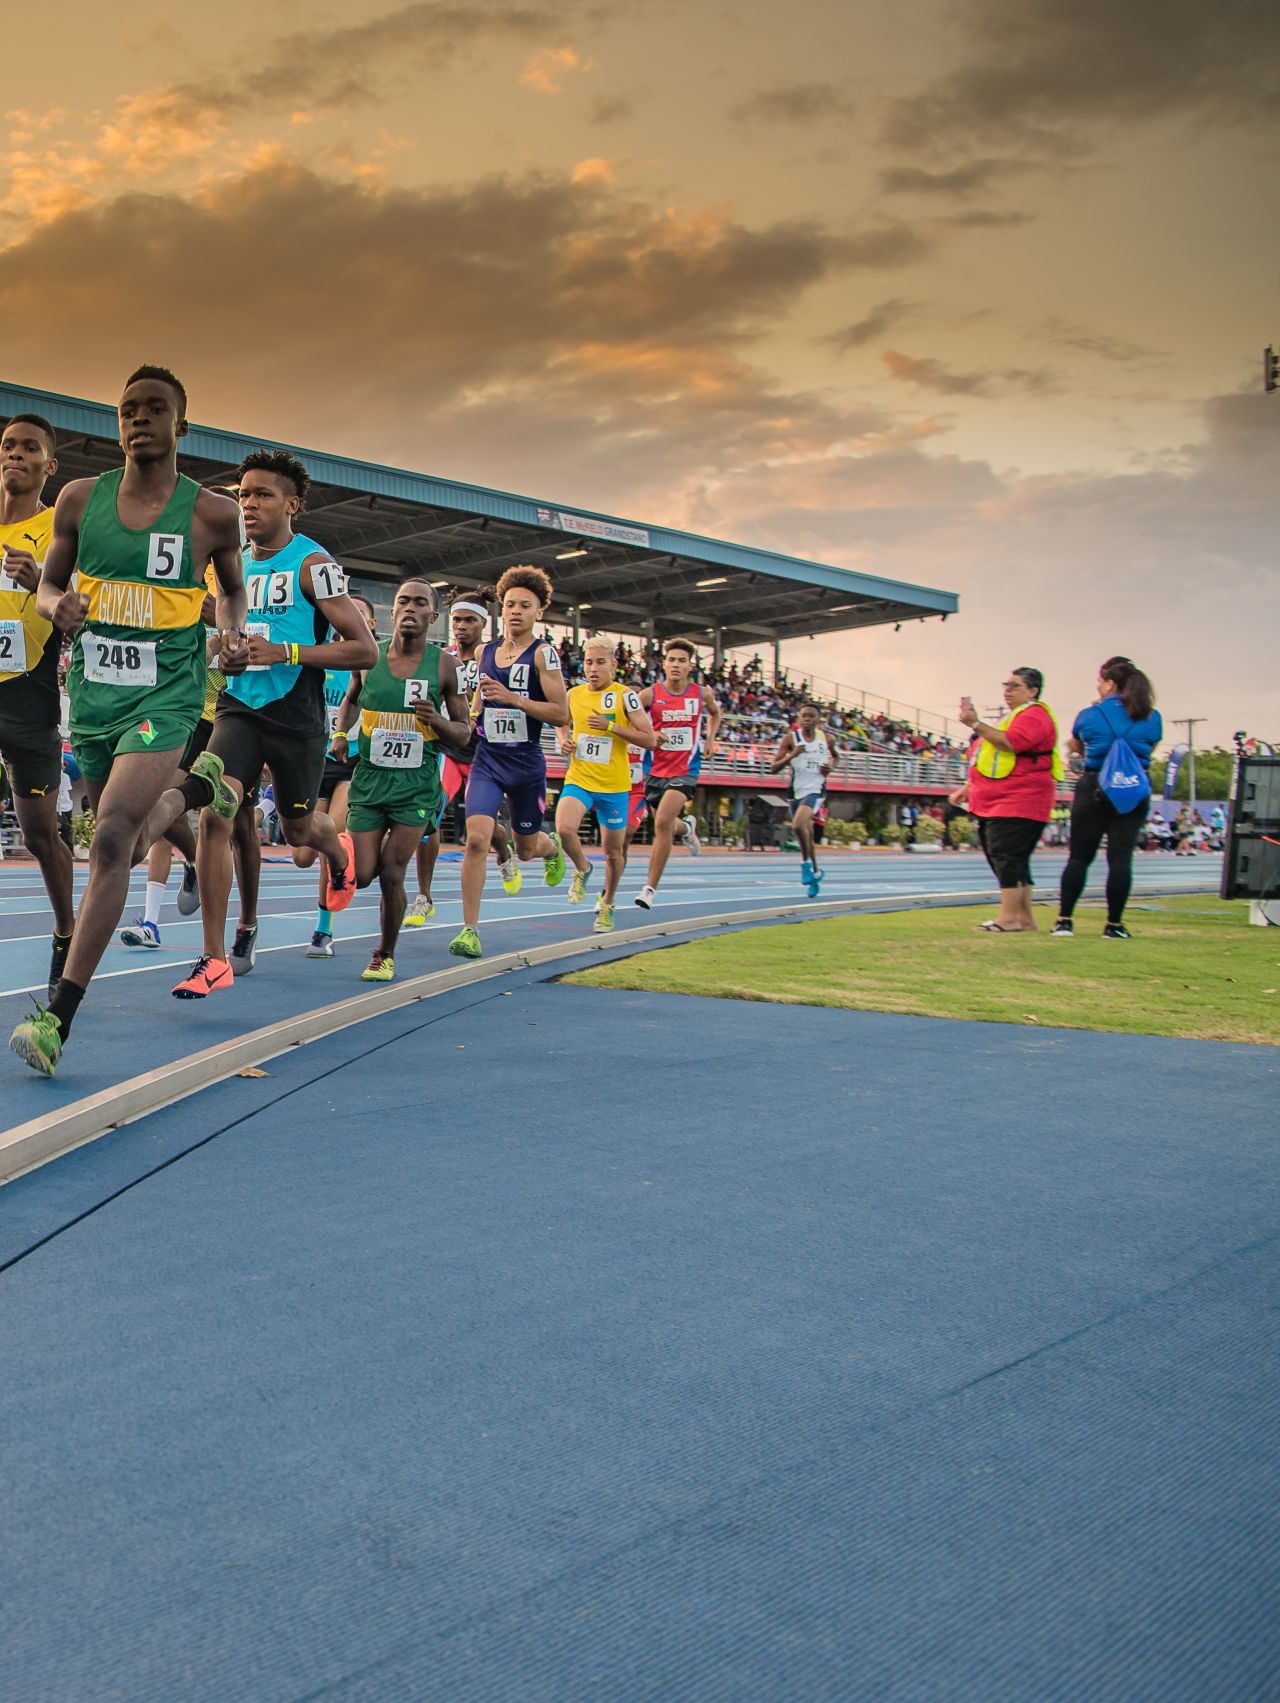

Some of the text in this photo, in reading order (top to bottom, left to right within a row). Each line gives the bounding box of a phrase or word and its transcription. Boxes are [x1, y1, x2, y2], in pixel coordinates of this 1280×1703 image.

[155, 537, 176, 576] 5
[98, 582, 154, 629] GUYANA
[96, 643, 141, 670] 248
[549, 648, 559, 668] 4
[513, 665, 525, 687] 4
[408, 681, 423, 706] 3
[604, 692, 613, 709] 6
[628, 692, 639, 709] 6
[689, 699, 695, 715] 1
[493, 719, 517, 734] 174
[382, 741, 412, 758] 247
[586, 743, 600, 756] 81
